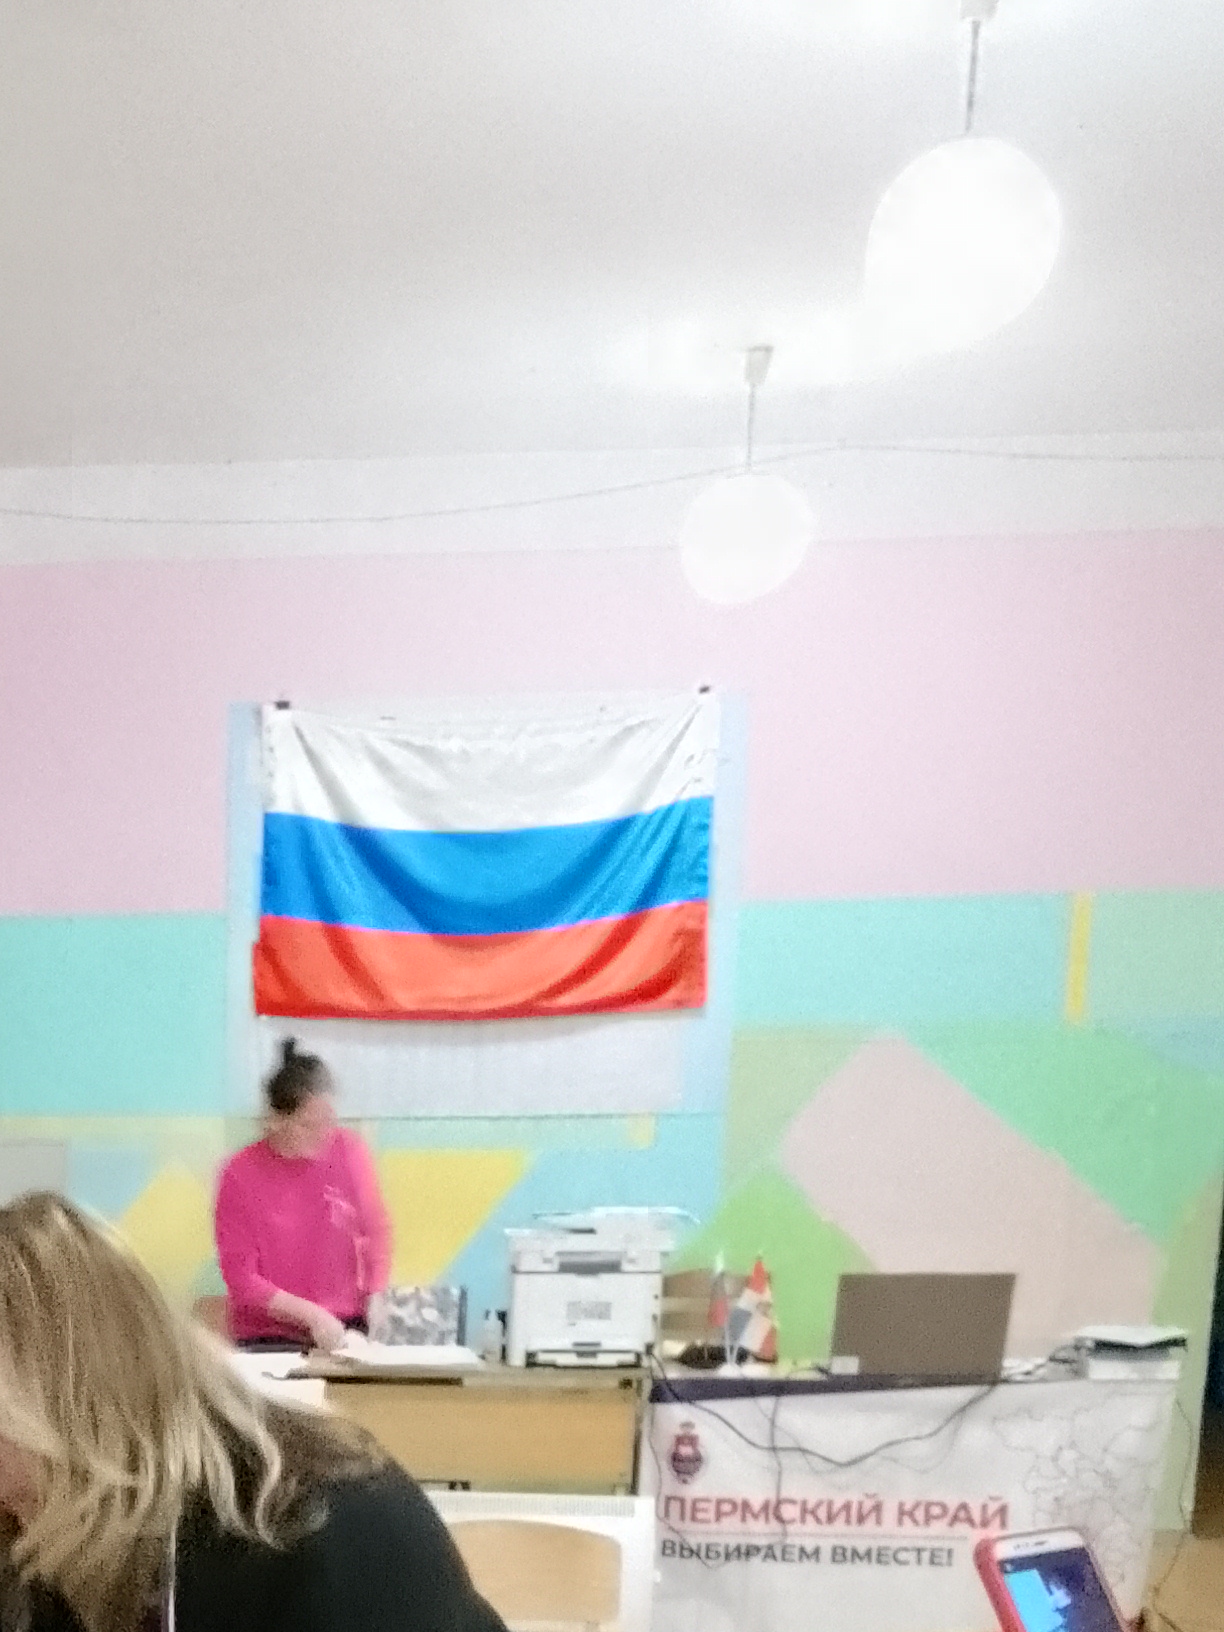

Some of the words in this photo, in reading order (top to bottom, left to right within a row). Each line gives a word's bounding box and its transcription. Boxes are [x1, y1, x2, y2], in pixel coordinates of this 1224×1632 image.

[663, 1493, 883, 1528] ПЕРМСКИЙ
[896, 1495, 1009, 1530] КРАЙ
[661, 1539, 821, 1564] ВЫБИРАЕМ
[831, 1545, 954, 1568] ВМЕСТЕ!
